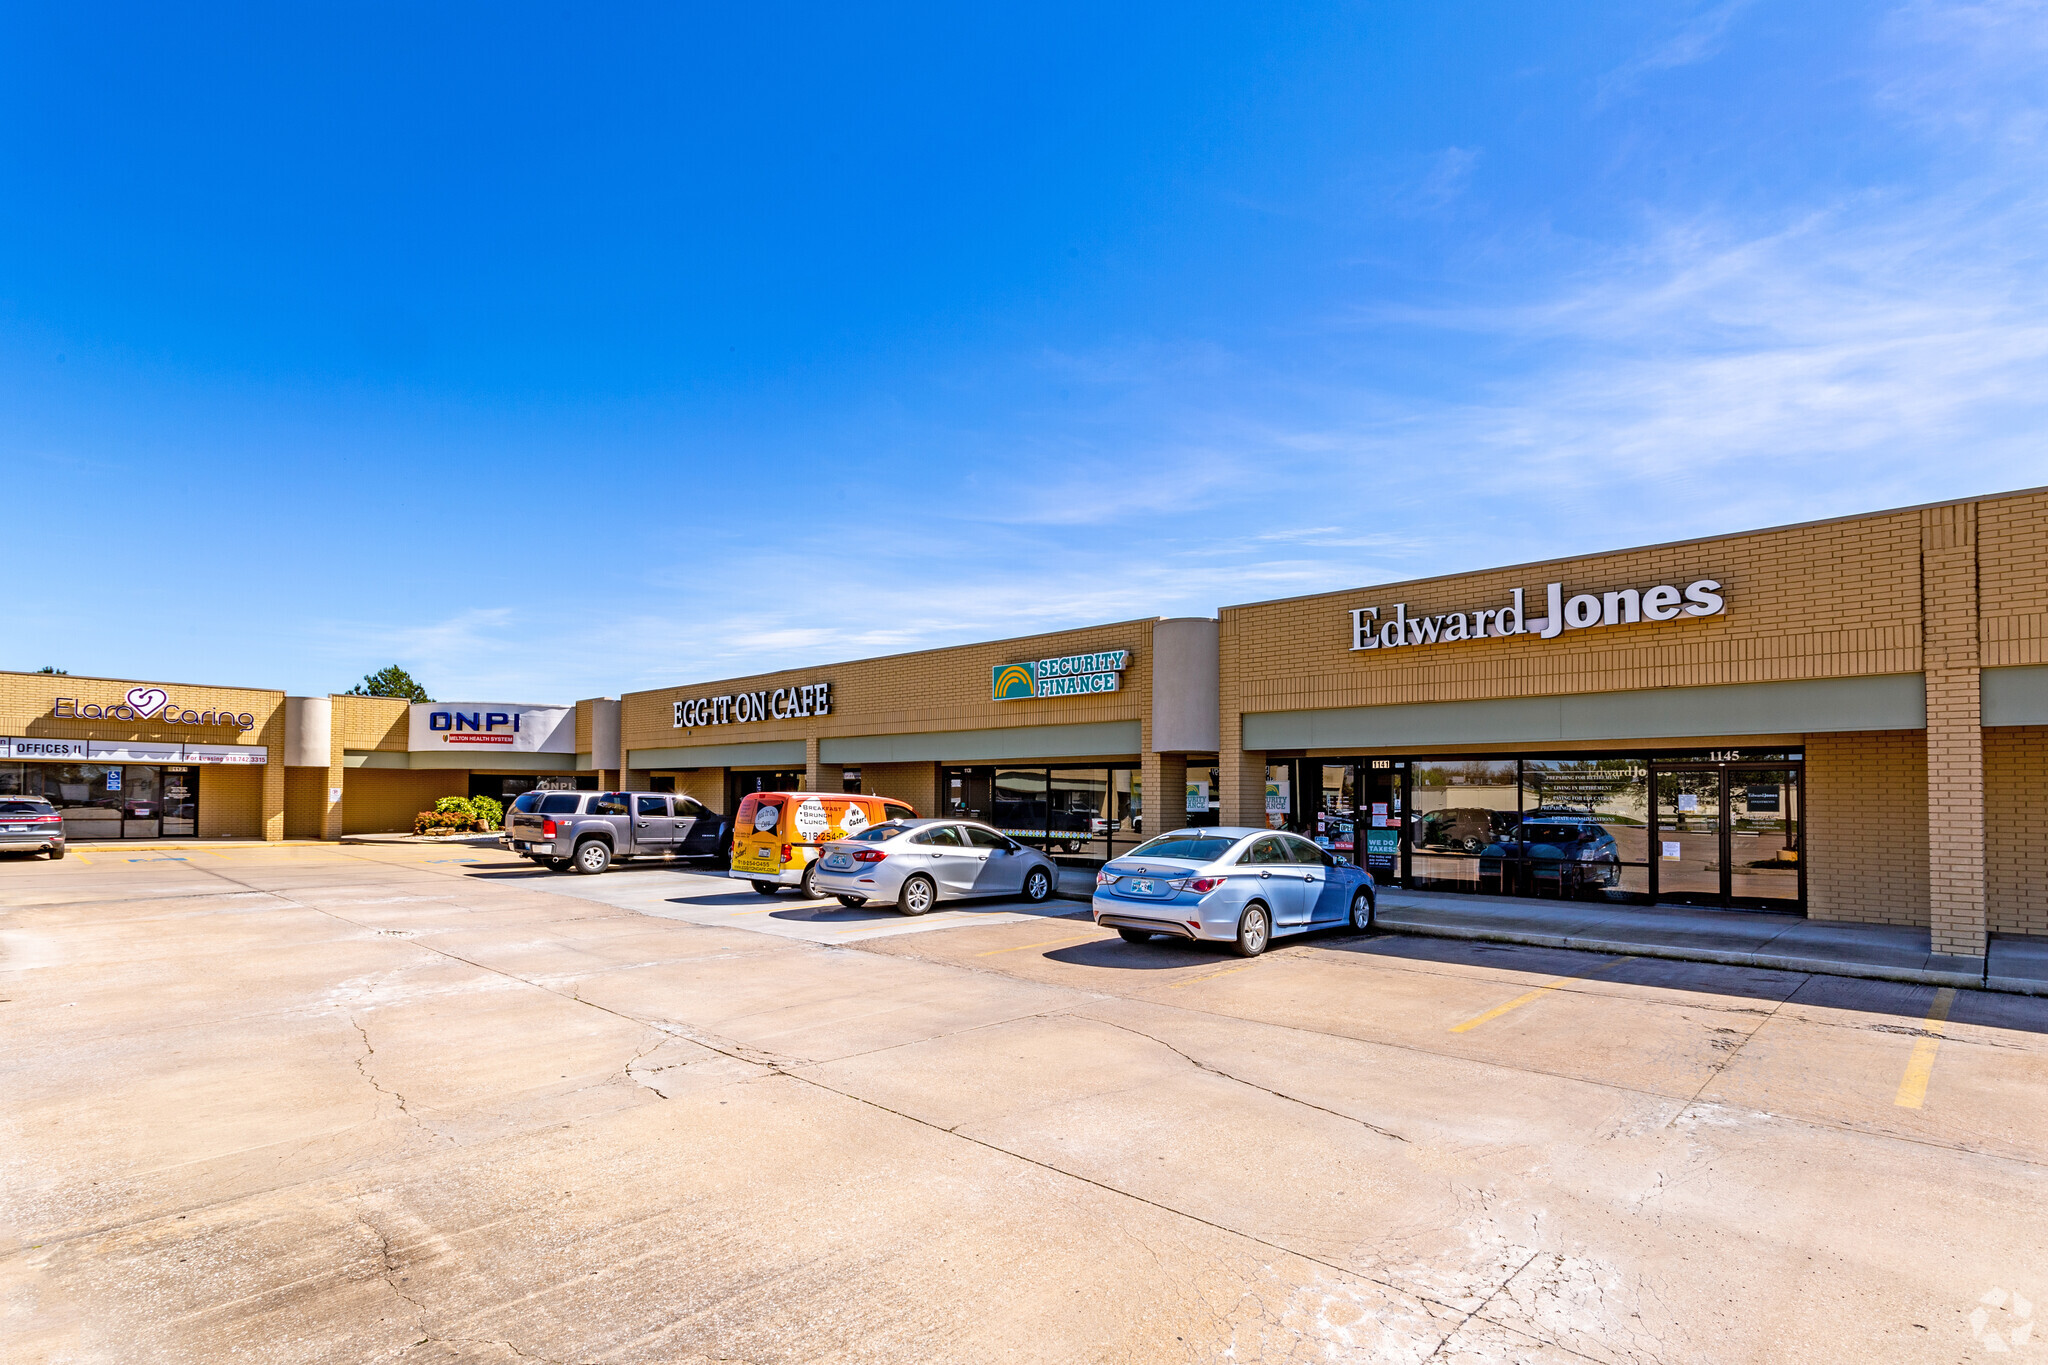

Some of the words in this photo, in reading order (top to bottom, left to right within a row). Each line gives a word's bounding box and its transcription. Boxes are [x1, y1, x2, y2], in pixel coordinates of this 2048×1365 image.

[1348, 587, 1529, 651] Edward
[1540, 579, 1724, 638] Jones
[1038, 651, 1124, 677] SECURITY
[1038, 673, 1115, 697] FINANCE
[673, 698, 709, 728] EGG
[712, 695, 733, 725] IT
[736, 691, 767, 723] ON
[771, 683, 829, 720] CAFE
[54, 697, 135, 721] Elara
[162, 704, 255, 732] Caring
[429, 712, 520, 732] ONPI
[17, 743, 69, 754] OFFICES
[199, 755, 224, 763] Leasing
[1709, 750, 1740, 761] 1145
[1373, 760, 1389, 768] 1141
[1633, 765, 1673, 777] Joes
[541, 782, 572, 790] ONPI
[850, 808, 860, 816] We
[848, 814, 867, 827] Cater!
